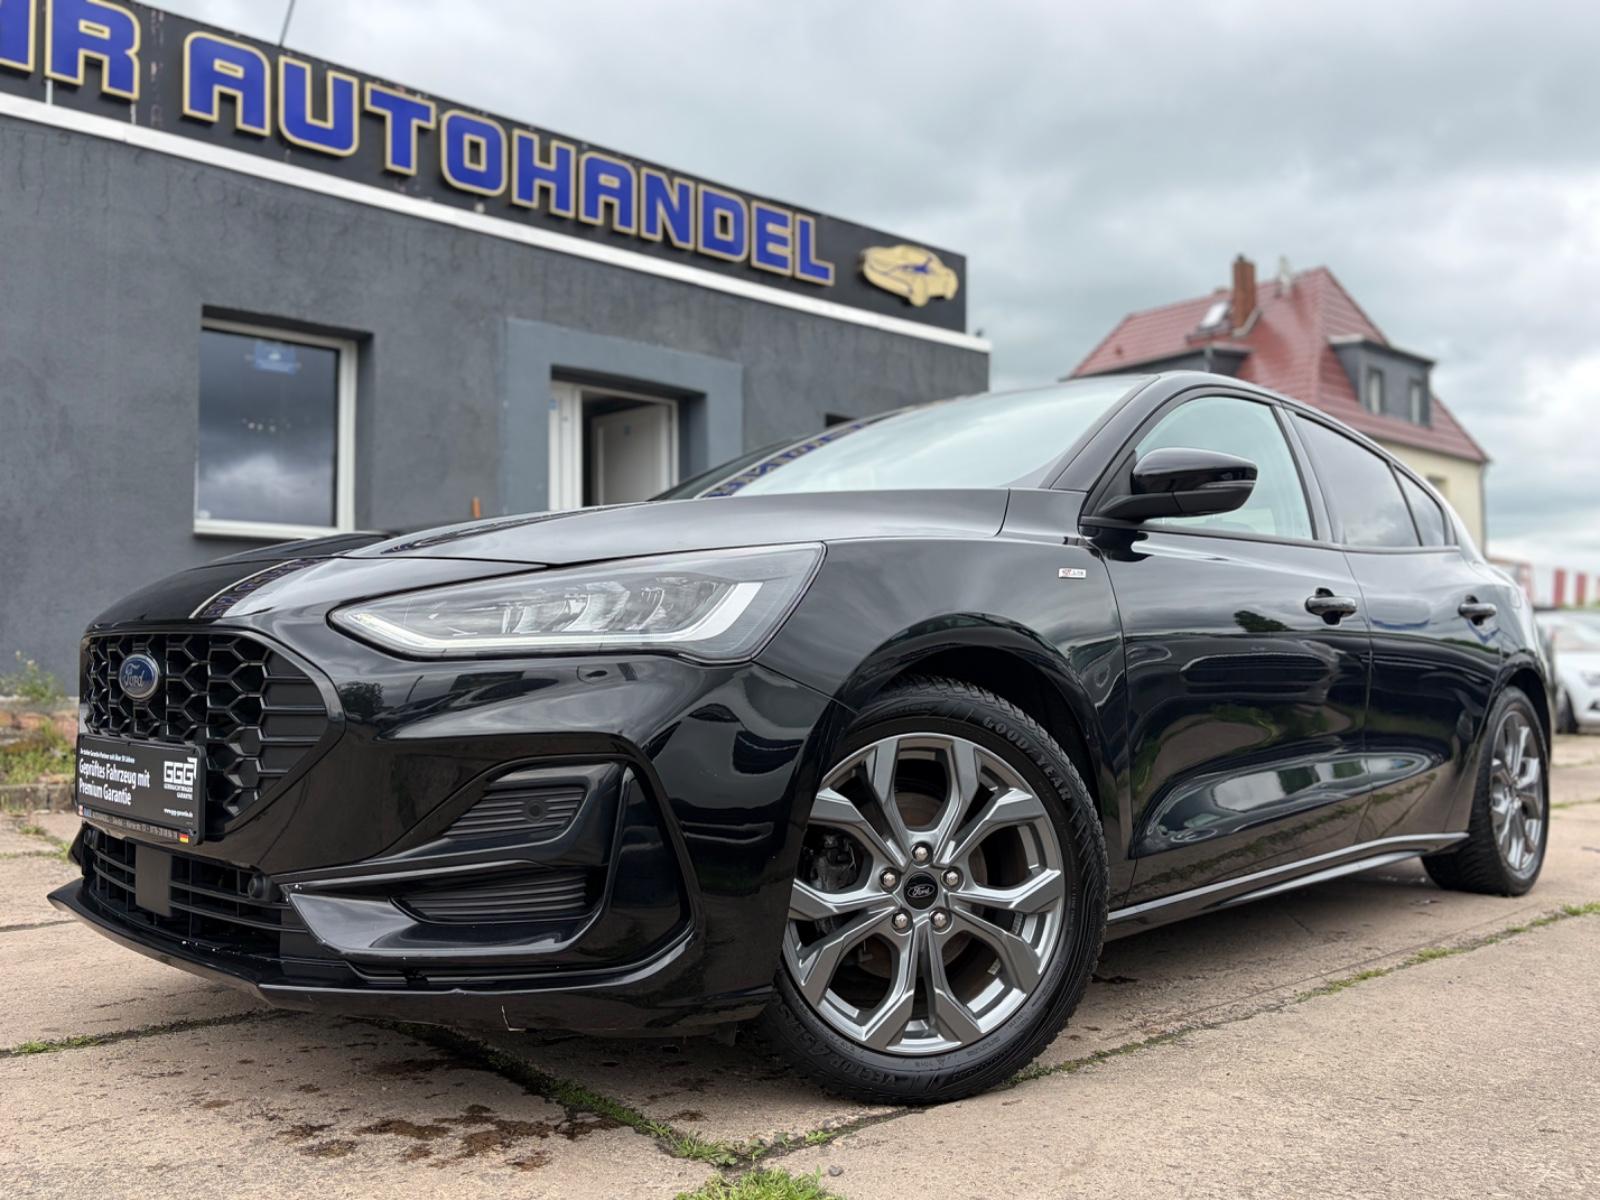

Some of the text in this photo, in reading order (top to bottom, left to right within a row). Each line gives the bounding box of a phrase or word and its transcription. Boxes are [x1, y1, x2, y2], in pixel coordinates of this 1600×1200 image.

[182, 31, 835, 287] AUTOHANDEL
[124, 662, 146, 688] Ford
[79, 758, 106, 780] Geprüftes
[106, 763, 137, 789] Fahrzeug
[137, 769, 151, 788] mit
[163, 760, 194, 785] GGG
[79, 777, 132, 806] Premium Garantie
